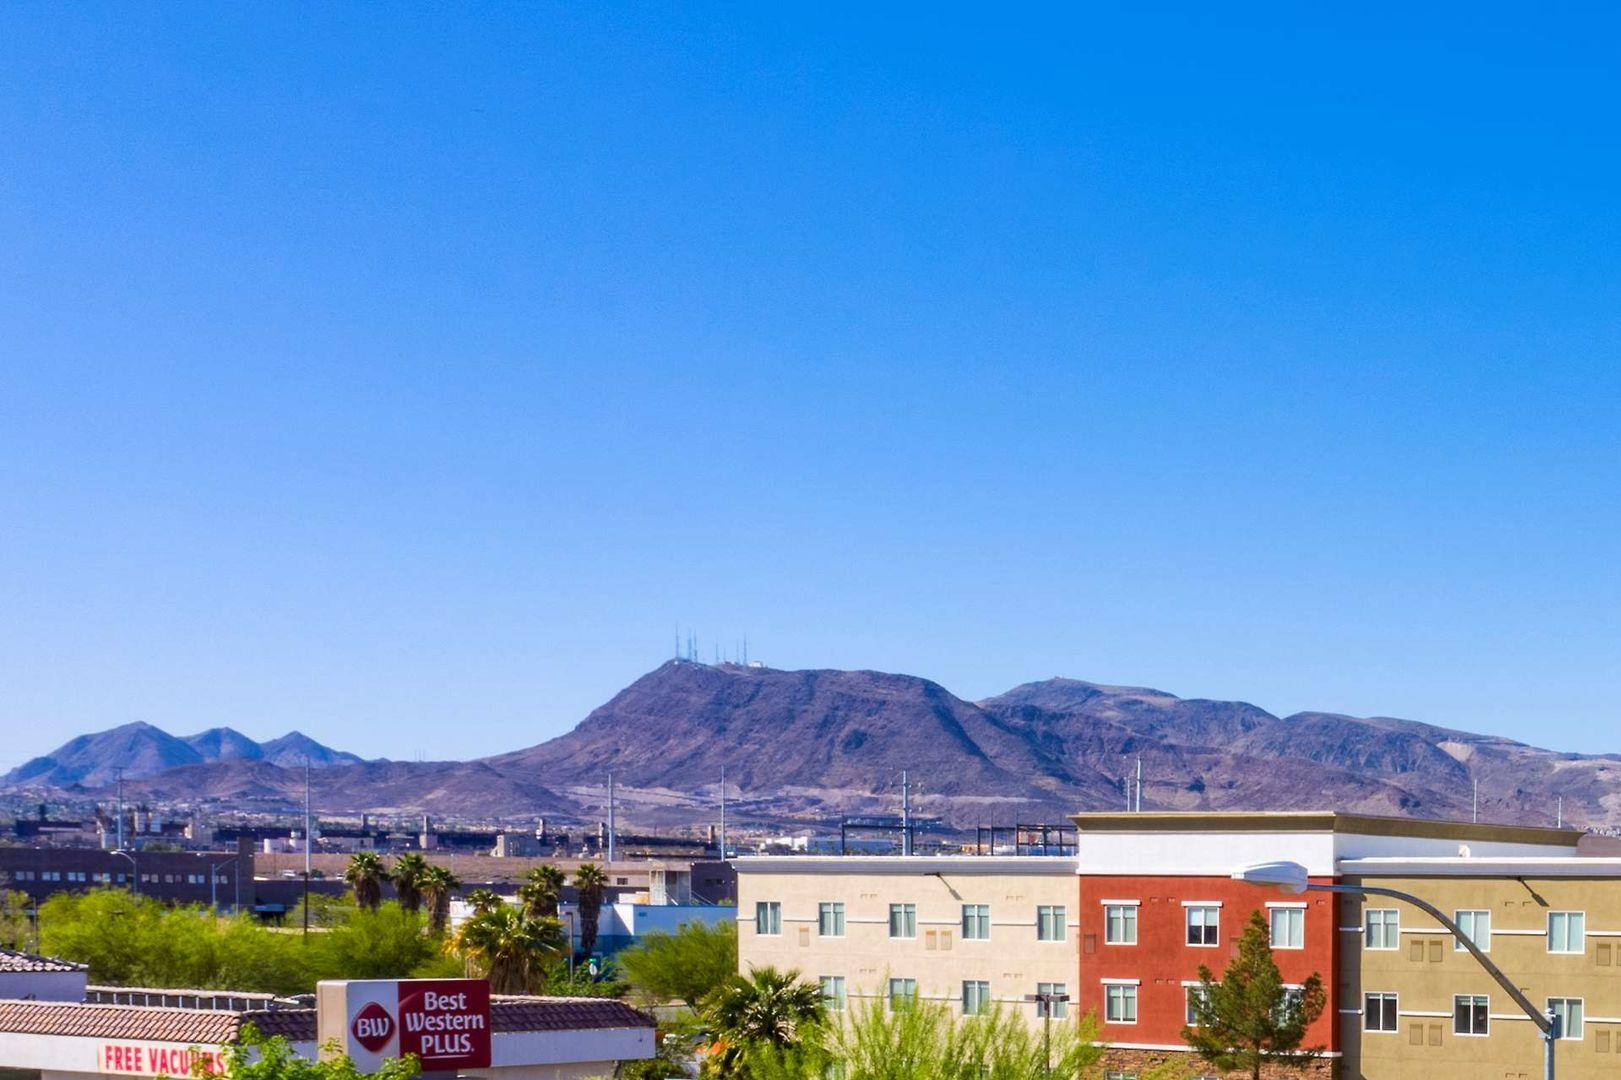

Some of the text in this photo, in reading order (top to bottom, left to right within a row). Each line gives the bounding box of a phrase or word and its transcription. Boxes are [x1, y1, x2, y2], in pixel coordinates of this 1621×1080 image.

[424, 991, 467, 1010] Best
[356, 1017, 390, 1038] BW
[405, 1012, 485, 1032] Western
[421, 1033, 471, 1054] PLUS
[105, 1045, 143, 1072] FREE
